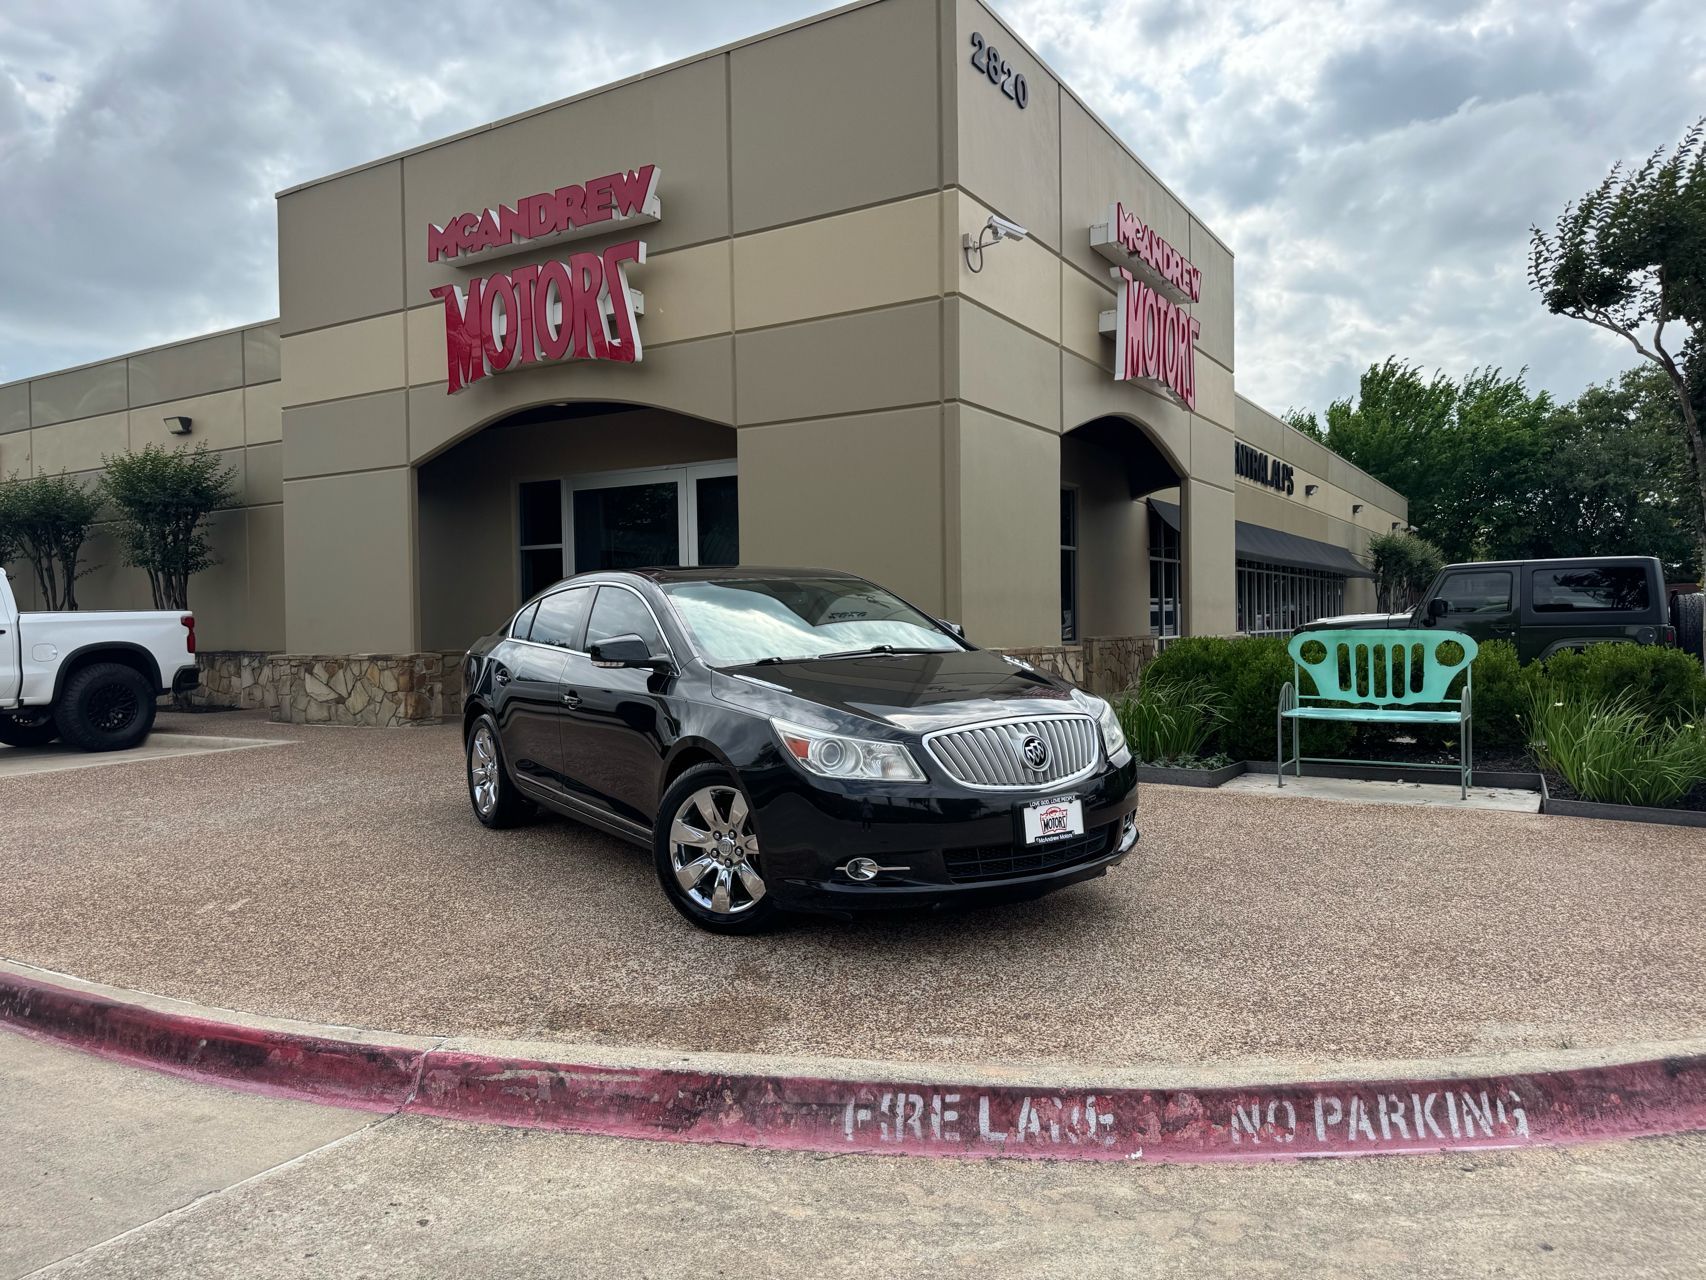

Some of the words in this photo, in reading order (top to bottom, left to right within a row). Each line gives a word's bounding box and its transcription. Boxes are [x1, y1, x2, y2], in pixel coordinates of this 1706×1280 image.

[970, 31, 1029, 110] 2820
[429, 240, 641, 396] MOTORS
[1119, 265, 1201, 412] MOTORS
[1042, 815, 1067, 832] MOTORS
[1061, 795, 1076, 803] PEOPLE
[1231, 1099, 1297, 1144] NO
[1313, 1090, 1529, 1142] PARKING
